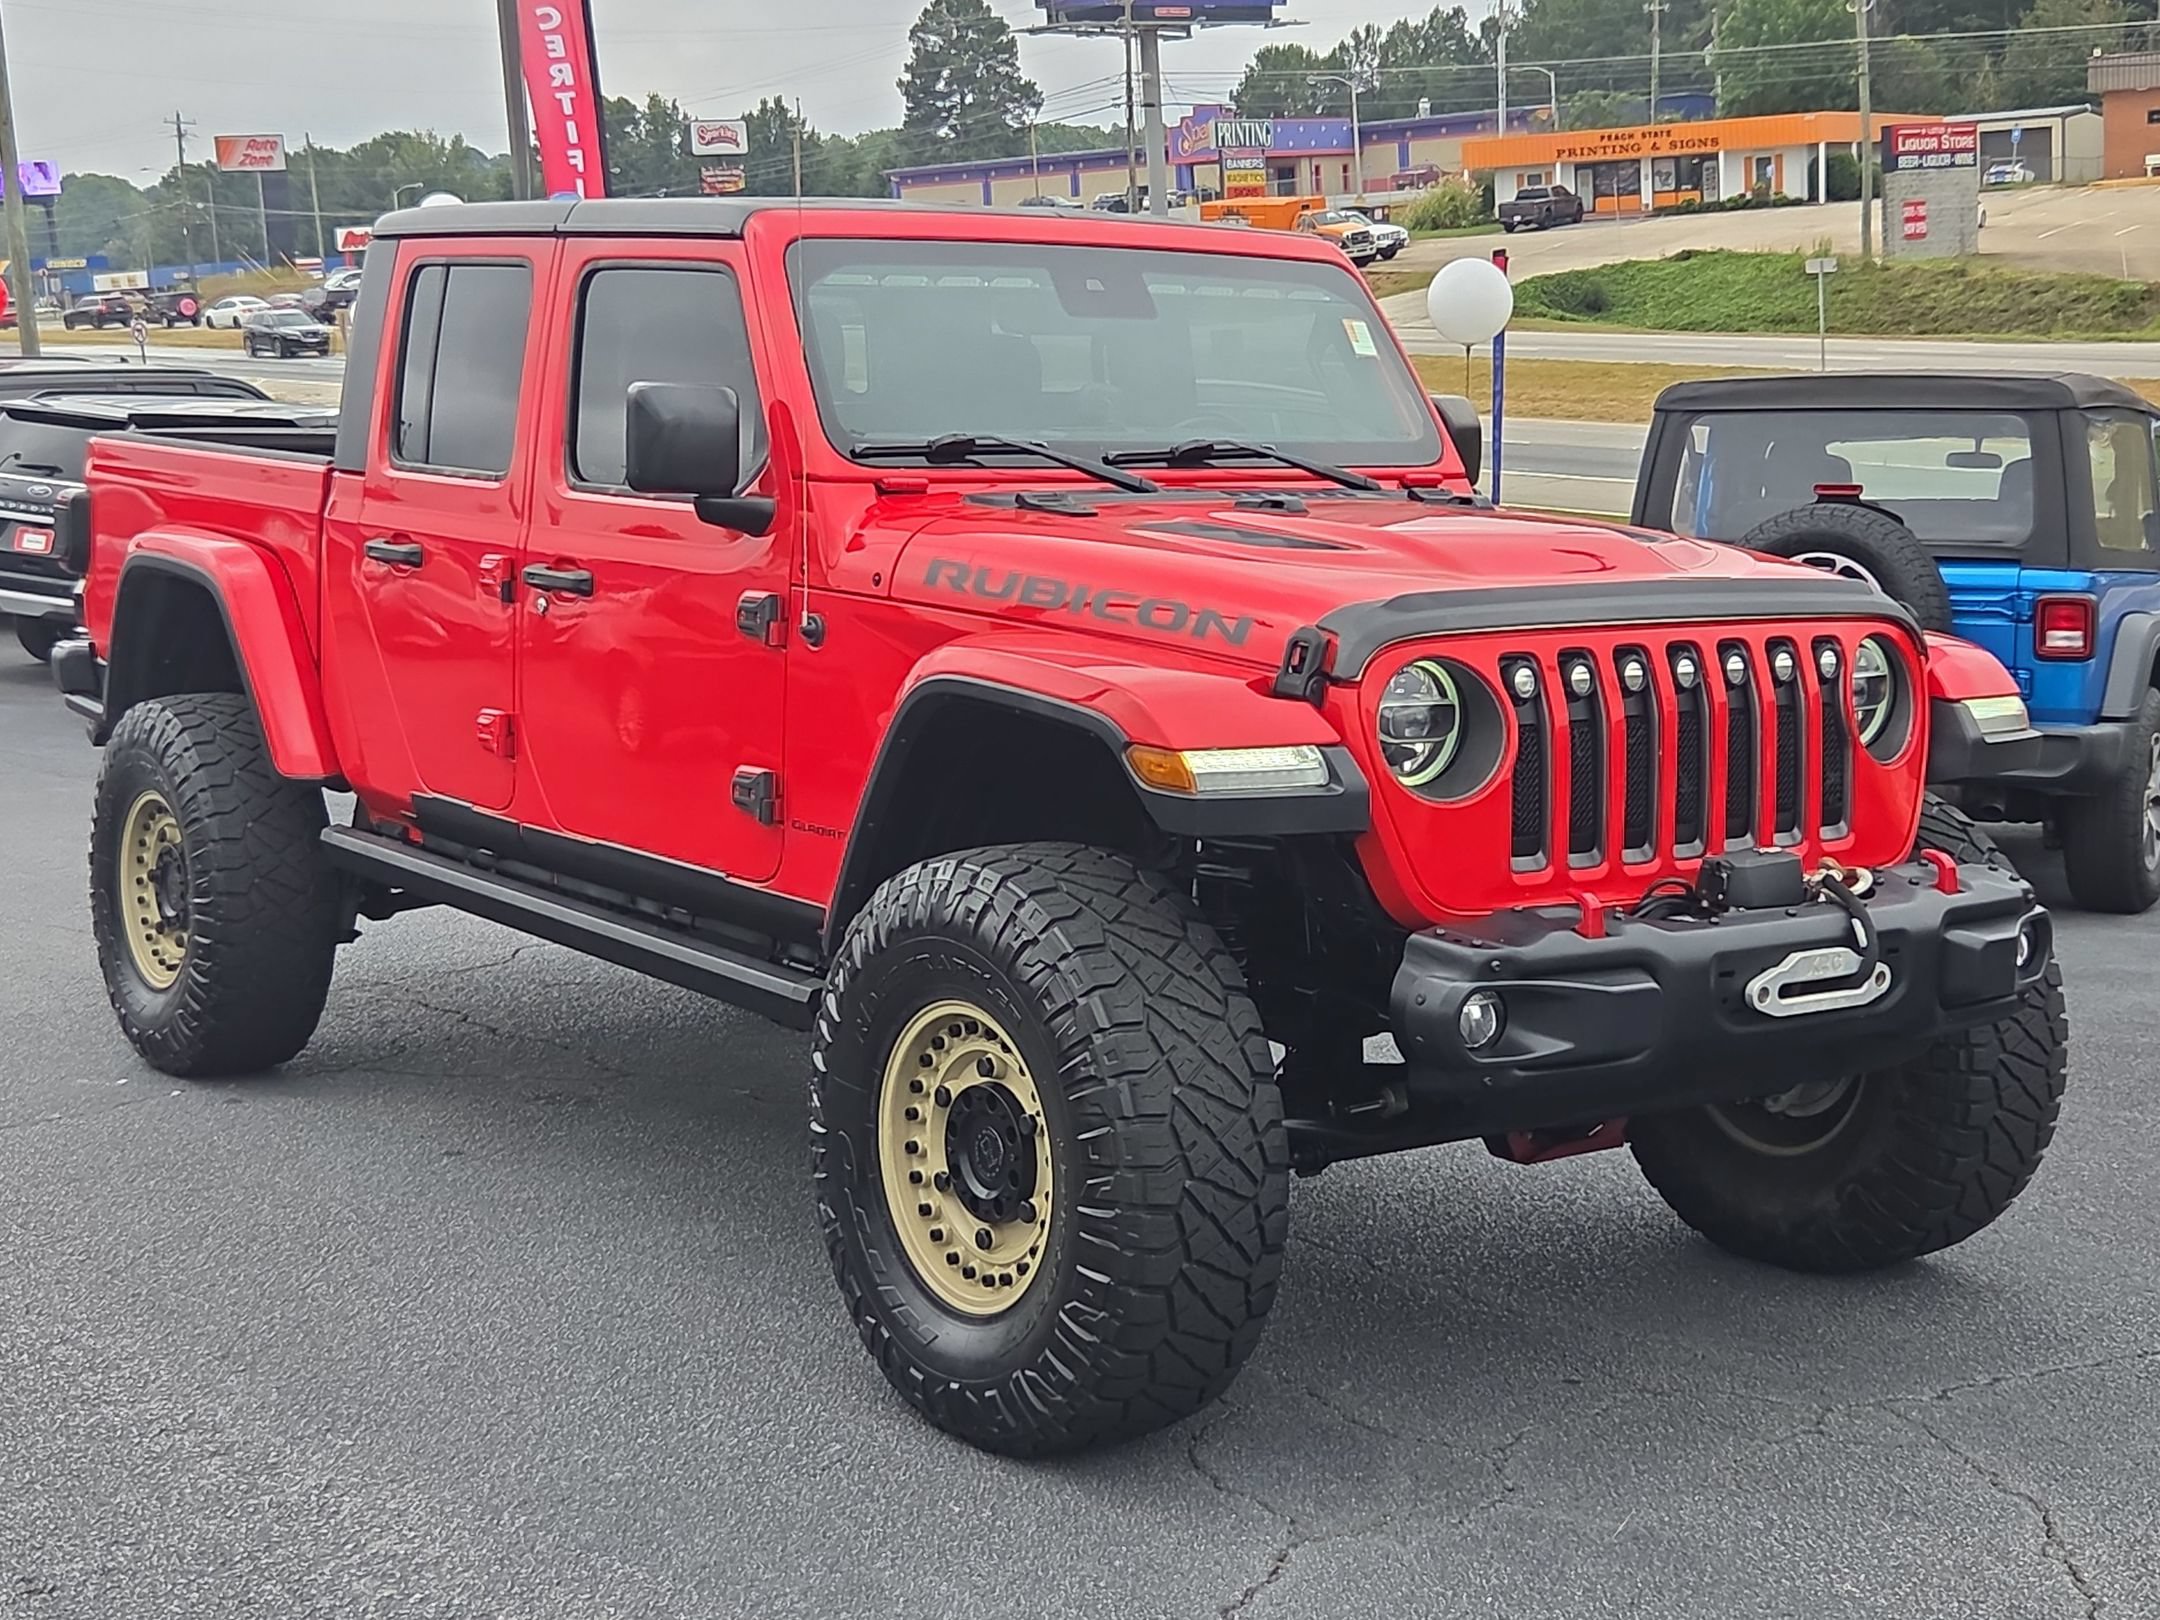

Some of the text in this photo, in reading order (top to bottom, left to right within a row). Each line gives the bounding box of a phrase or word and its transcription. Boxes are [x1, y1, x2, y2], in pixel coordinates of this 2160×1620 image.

[1216, 121, 1272, 147] PRINTING
[1600, 130, 1672, 142] PEACH STATE
[246, 138, 279, 151] Auto
[1556, 136, 1720, 159] PRINTING & SIGNS
[1897, 133, 1976, 152] LIQUOR STORE
[238, 153, 274, 167] Zone
[1225, 158, 1265, 169] BANNERS
[922, 558, 1256, 646] RUBICON
